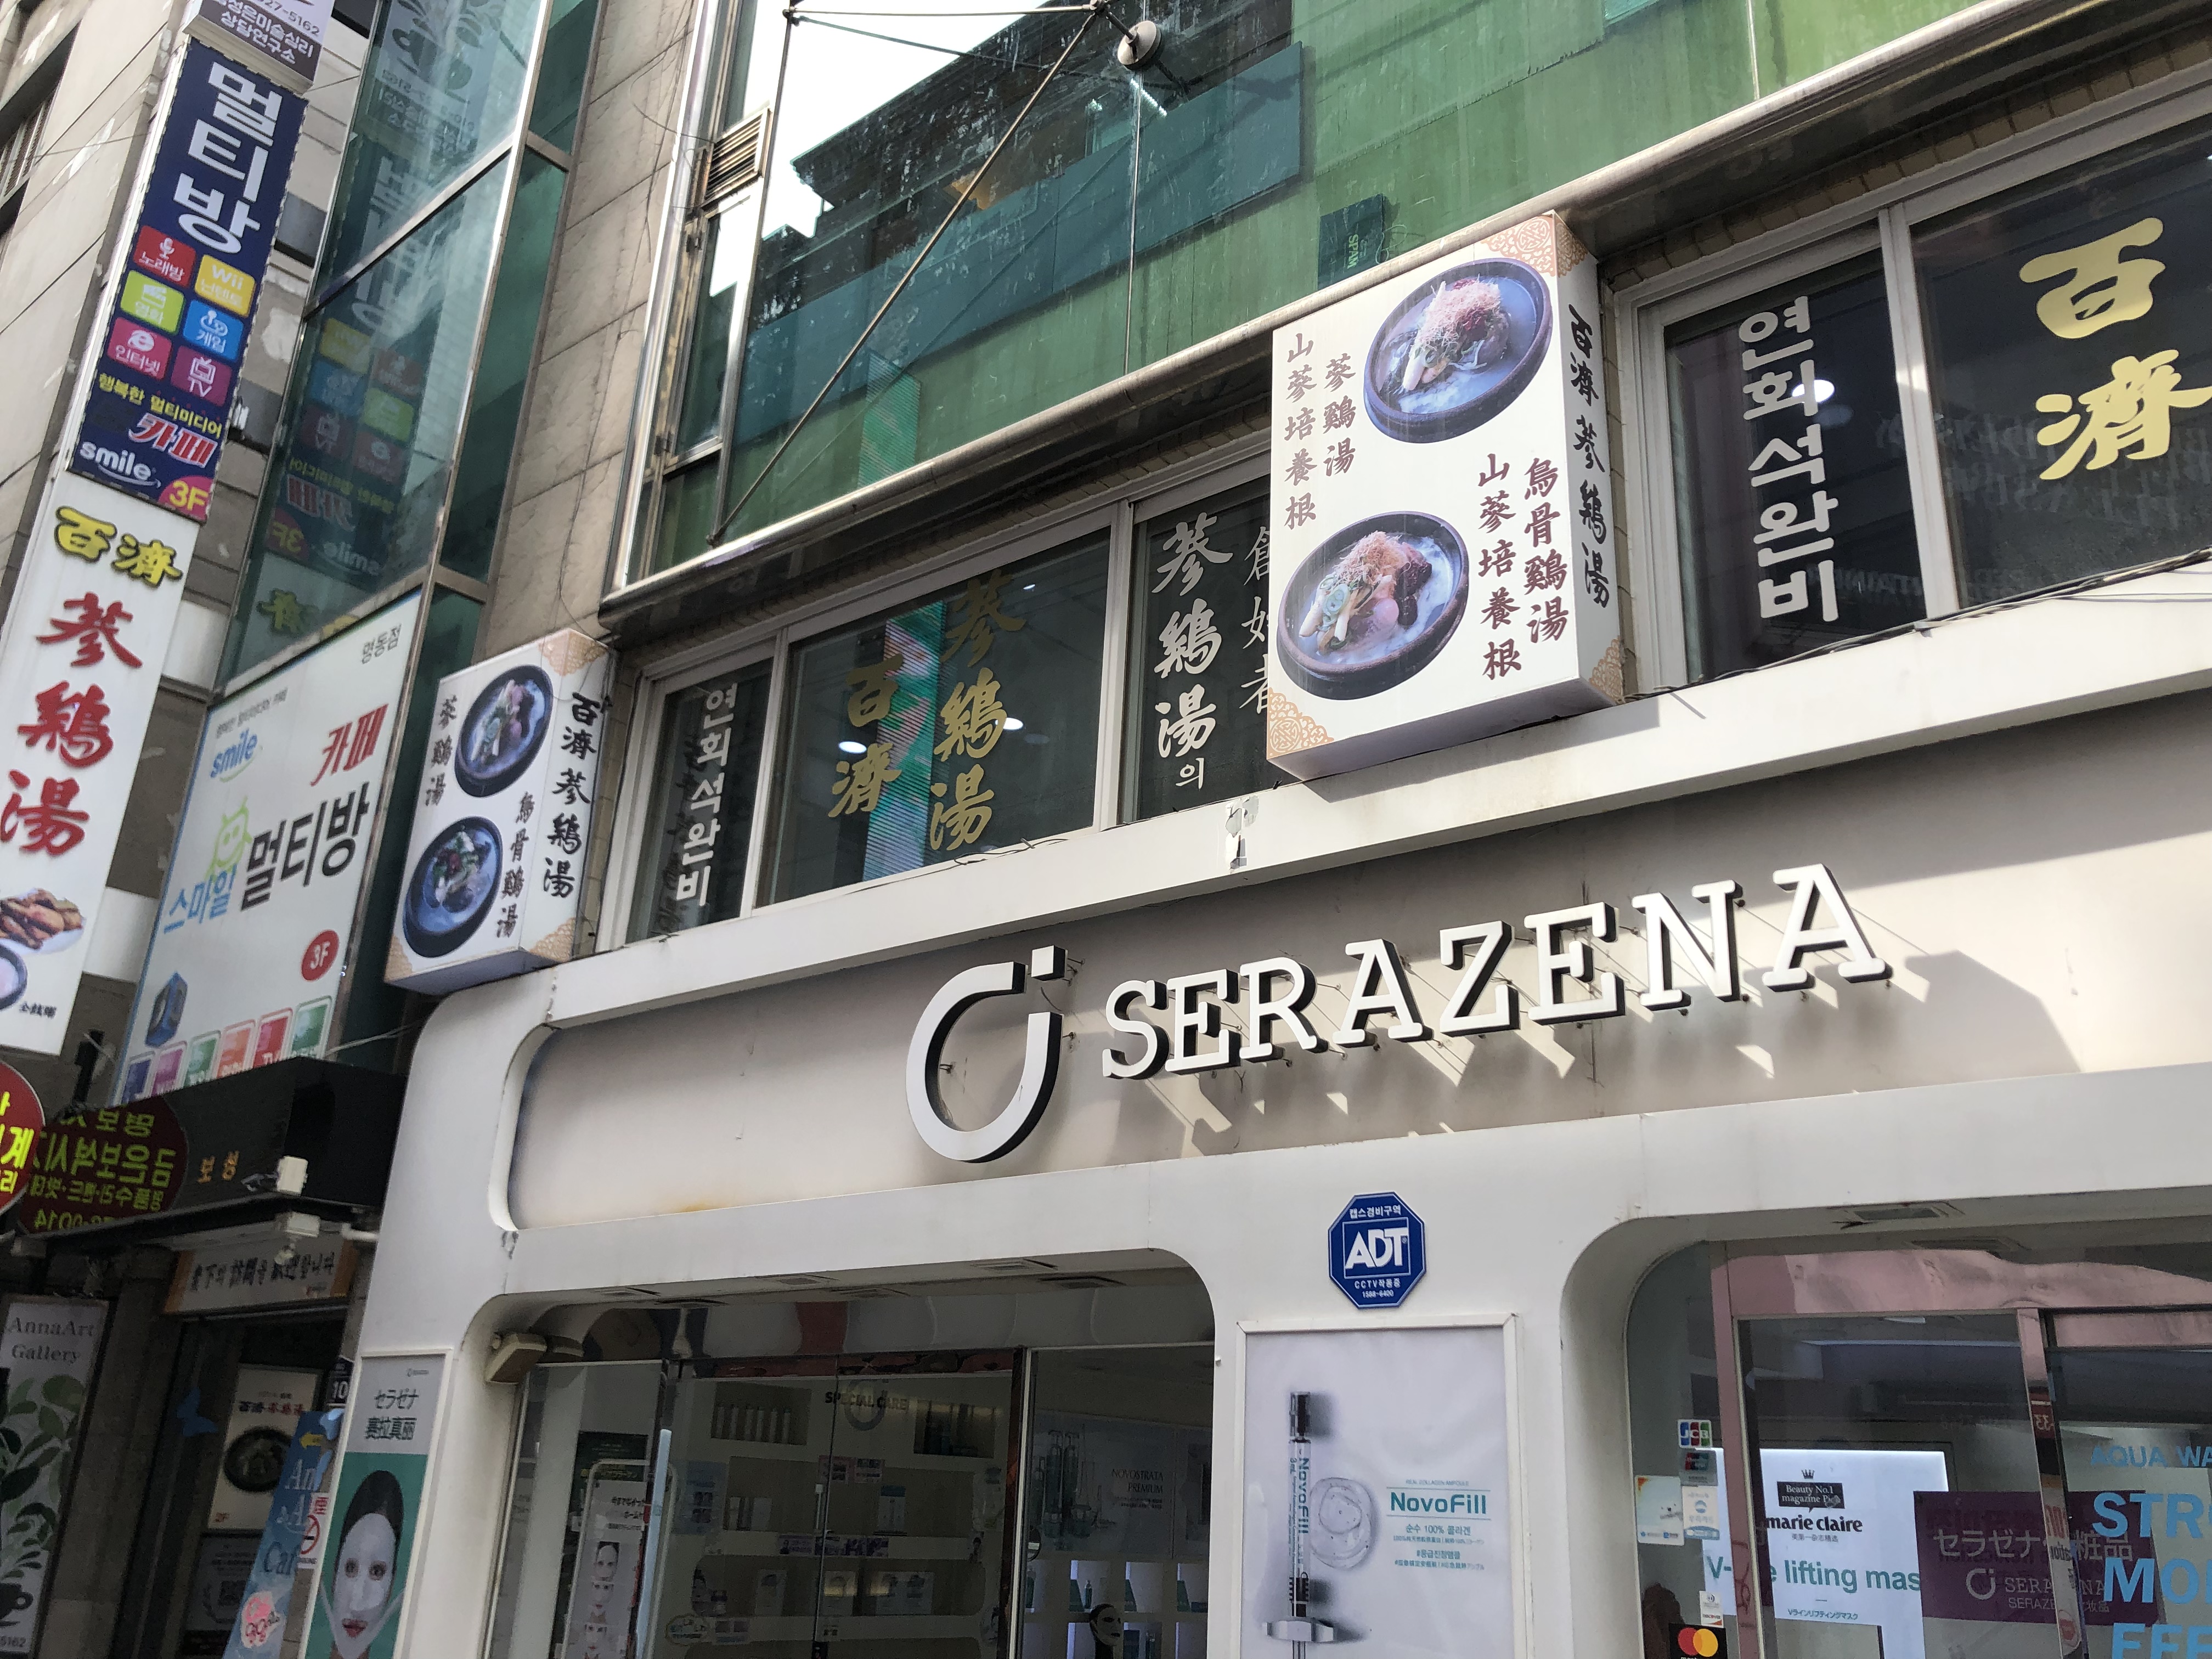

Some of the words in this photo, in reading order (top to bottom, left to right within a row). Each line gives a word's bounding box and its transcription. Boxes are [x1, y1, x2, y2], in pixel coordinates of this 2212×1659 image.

[258, 0, 319, 36] 27-5162
[221, 11, 296, 64] 상담연구소
[172, 60, 283, 255] 멀티방
[138, 251, 185, 283] 노래방
[1347, 234, 1359, 269] SPAM
[212, 264, 244, 289] Wii
[134, 301, 165, 325] 영화
[195, 329, 226, 355] 게임
[115, 345, 160, 376] 인터넷
[188, 376, 213, 398] TV
[99, 372, 145, 406] 행복한
[150, 394, 223, 439] 멀티미디어
[128, 412, 219, 469] 카페
[78, 441, 153, 481] smile
[1737, 295, 1839, 623] 연회석완비
[169, 480, 209, 512] 3F
[361, 624, 403, 664] 명동점
[210, 727, 258, 778] smile
[310, 703, 389, 787] 카페
[674, 682, 738, 907] 연회석완비
[241, 781, 370, 911] 멀티방
[165, 863, 237, 934] 스마일
[309, 940, 331, 971] 3F
[1102, 863, 1893, 1081] SERAZENA
[1348, 1204, 1402, 1219] 캡스경비구역
[1344, 1227, 1409, 1270] ADT
[1353, 1277, 1401, 1289] CCTV작동중
[1361, 1290, 1395, 1299] 1588-6400
[10, 1344, 81, 1365] Gallery
[373, 1387, 420, 1410] セラゼナ
[1680, 1429, 1710, 1439] JCB
[2090, 1444, 2168, 1468] AQUA
[1111, 1468, 1164, 1482] NOVOSTRATA
[1128, 1482, 1164, 1494] PREMIUM
[1786, 1485, 1813, 1497] Beauty
[1815, 1485, 1834, 1494] No.1
[1298, 1457, 1310, 1535] NovoFill
[1390, 1491, 1487, 1515] NovoFill
[1782, 1494, 1821, 1505] magazine
[1406, 1523, 1421, 1534] 순수
[1424, 1524, 1445, 1534] 100%
[1447, 1525, 1472, 1536] 콜라겐
[1766, 1514, 1813, 1531] marie
[1816, 1516, 1863, 1532] claire
[2092, 1491, 2212, 1539] STR
[1784, 1559, 1859, 1594] lifting
[1866, 1569, 1921, 1592] mas
[2005, 1576, 2106, 1596] SERANA
[2103, 1557, 2212, 1605] MO
